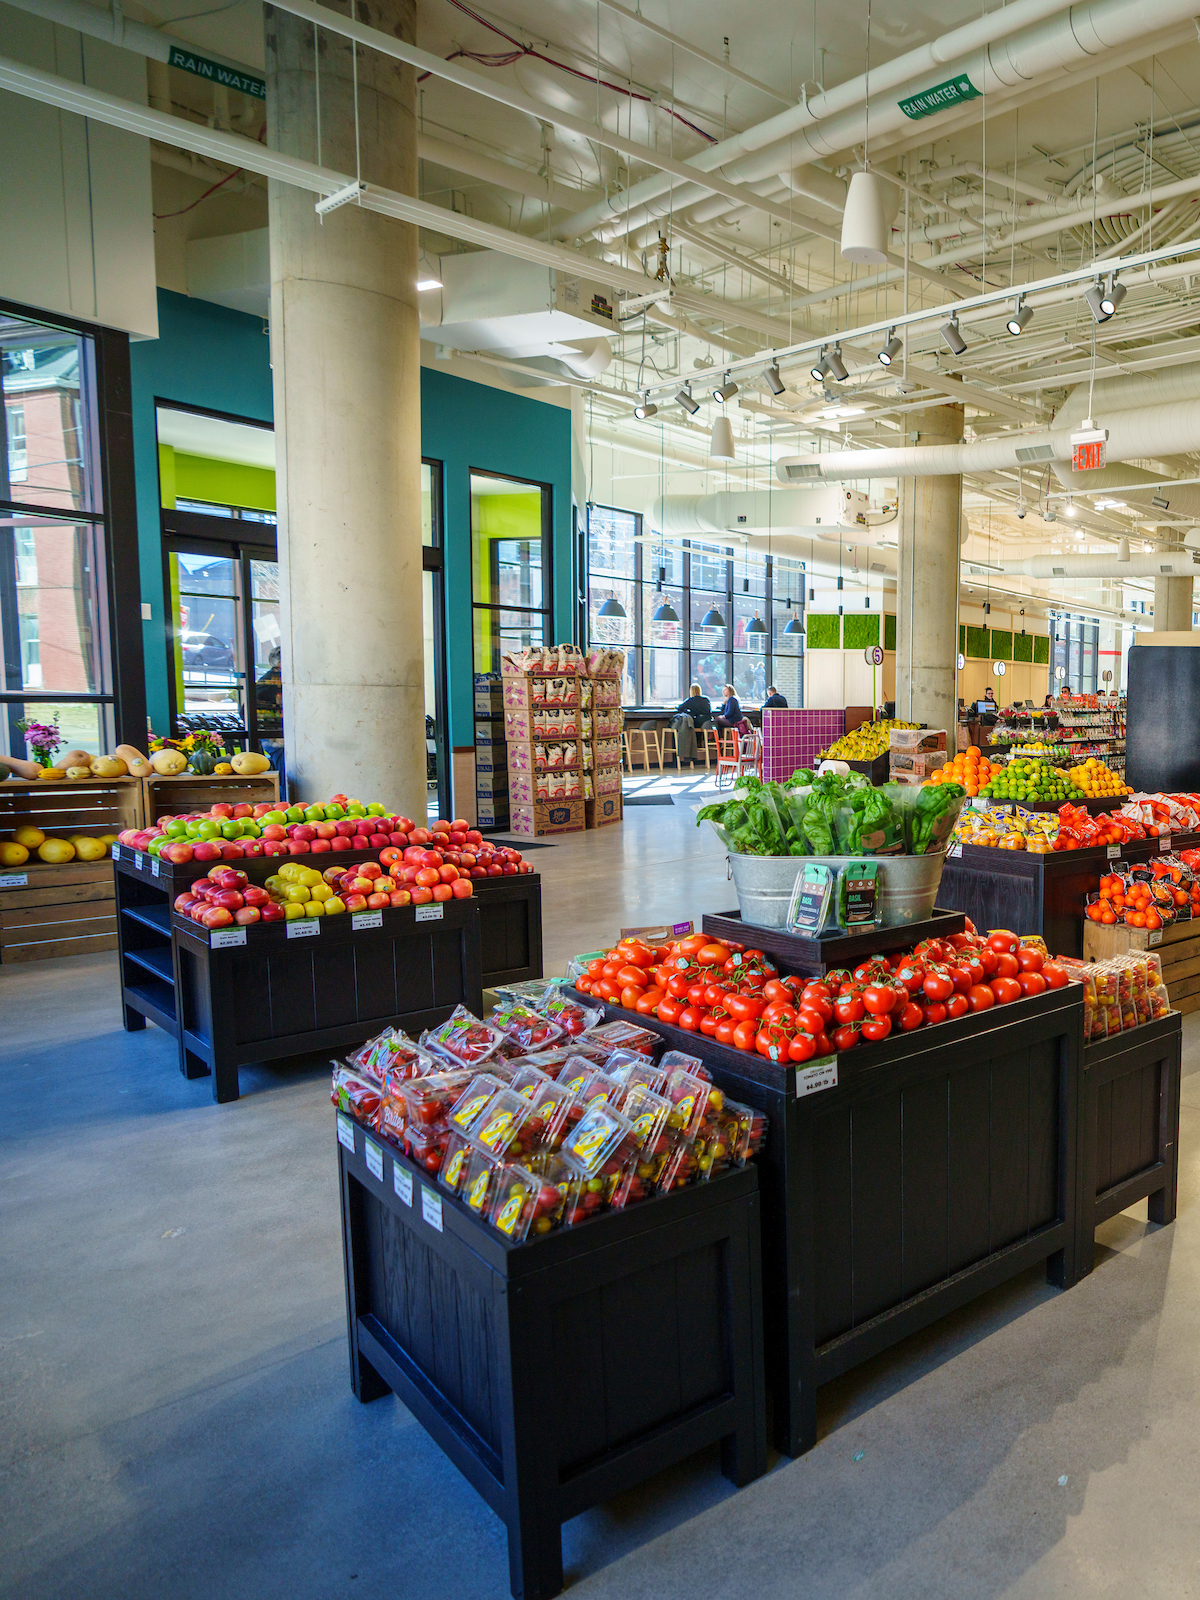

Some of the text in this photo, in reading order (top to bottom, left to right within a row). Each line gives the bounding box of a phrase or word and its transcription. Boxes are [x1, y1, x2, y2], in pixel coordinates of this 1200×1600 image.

[173, 52, 213, 77] RAIN
[902, 84, 961, 116] RAIN WATER
[1077, 442, 1103, 470] EXIT
[874, 649, 881, 663] 5
[848, 894, 862, 902] BASIL
[803, 1072, 818, 1080] TOMATO
